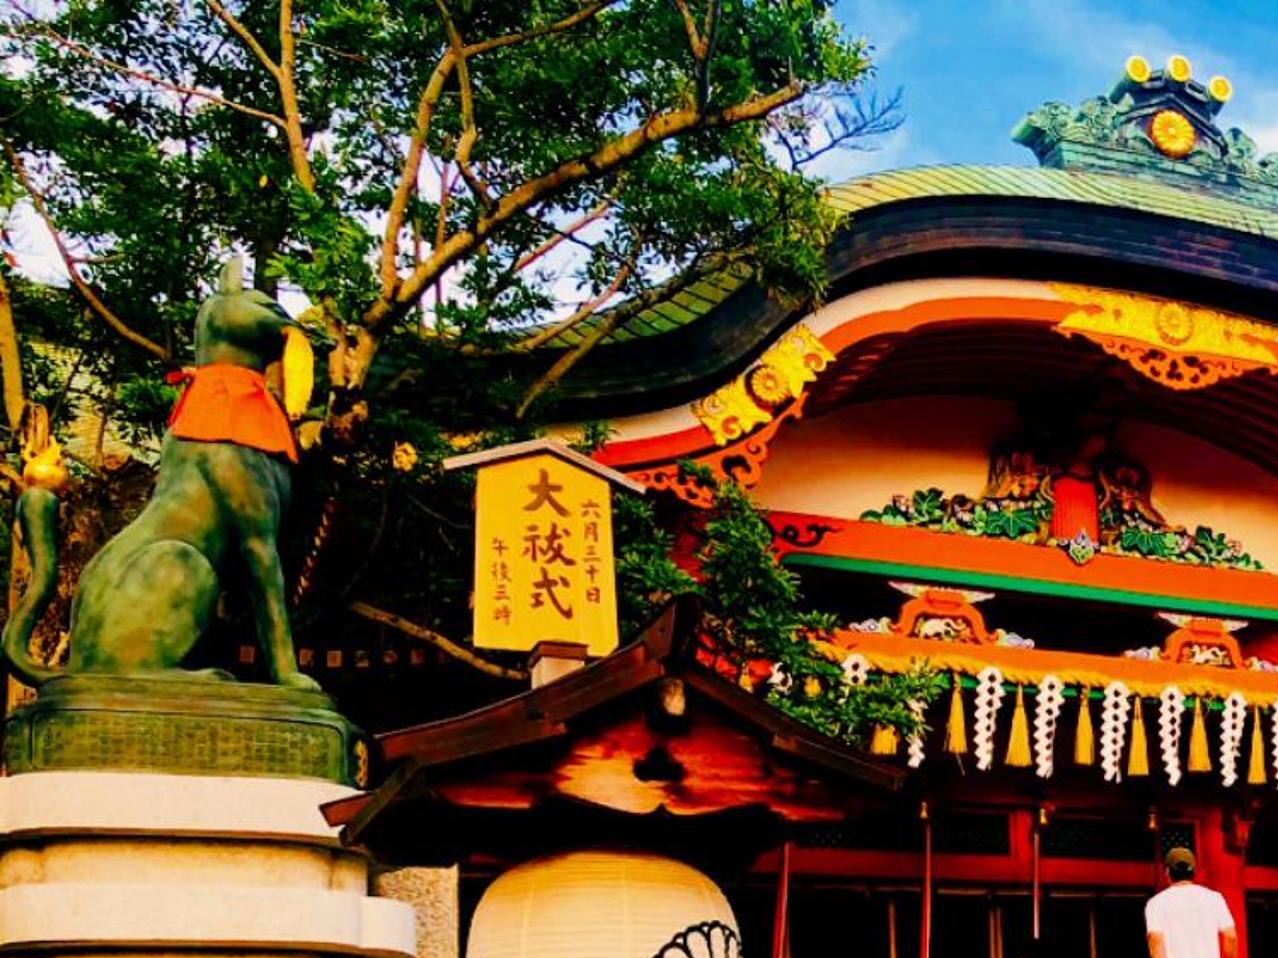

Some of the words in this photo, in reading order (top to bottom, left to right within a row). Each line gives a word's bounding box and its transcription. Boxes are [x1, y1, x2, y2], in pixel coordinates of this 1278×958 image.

[491, 537, 512, 626] 午後三時
[522, 468, 576, 620] 大祓式
[581, 499, 602, 604] 六月三十日
